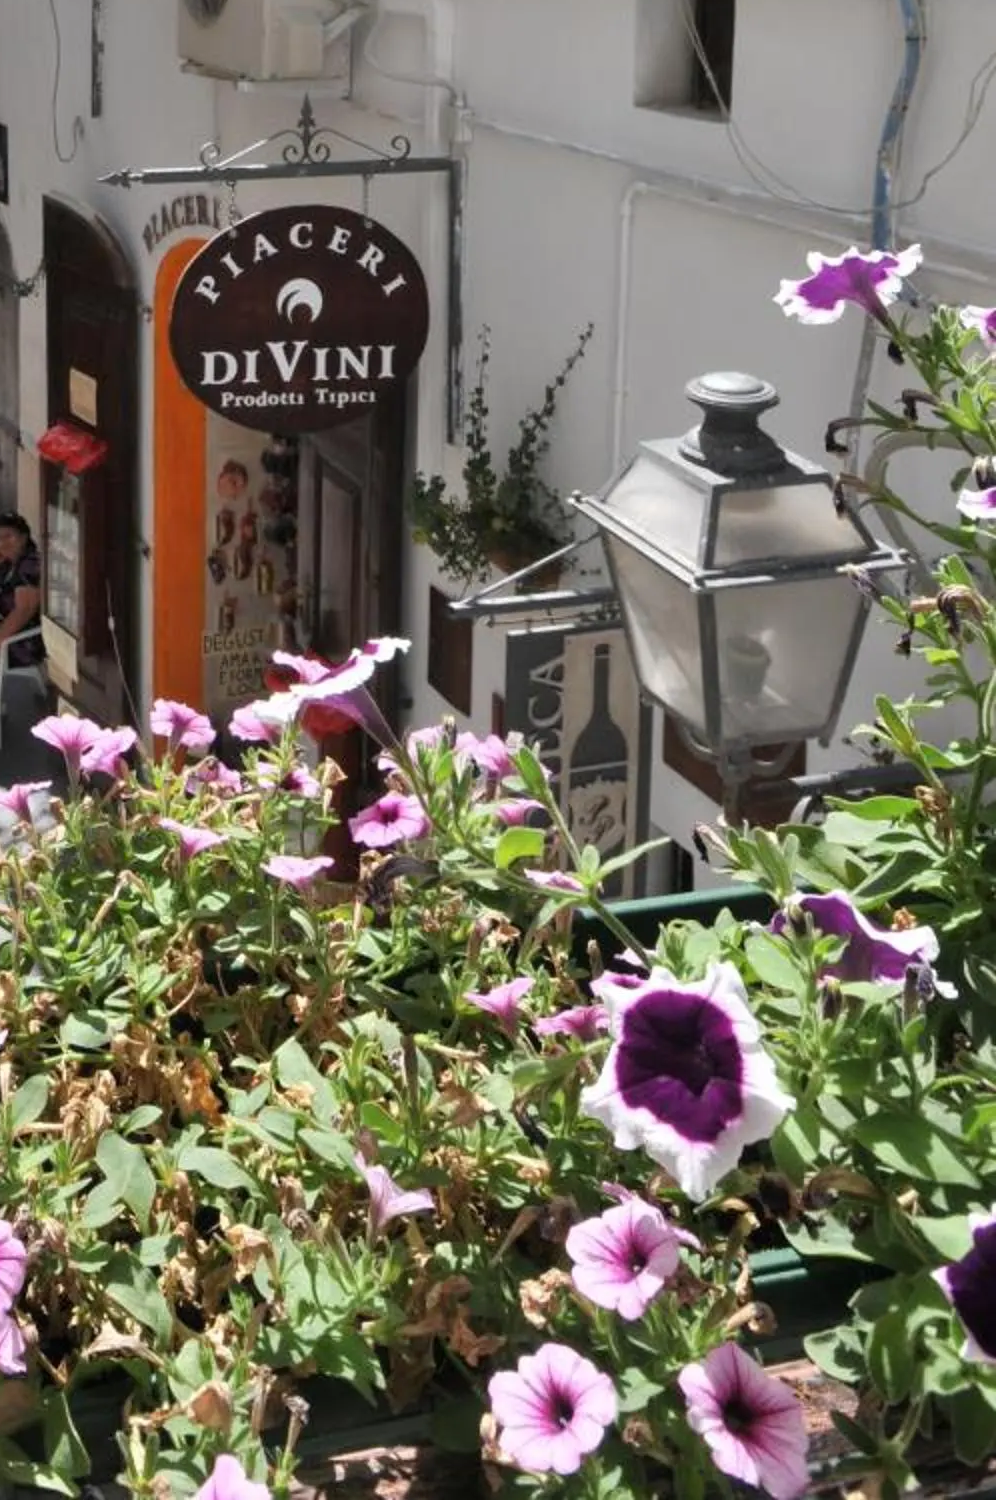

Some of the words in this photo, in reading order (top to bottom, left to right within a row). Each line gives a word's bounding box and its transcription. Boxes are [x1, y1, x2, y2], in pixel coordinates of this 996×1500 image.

[194, 222, 407, 304] PIACERI
[220, 391, 304, 408] Prodotti
[314, 387, 376, 409] Tipici
